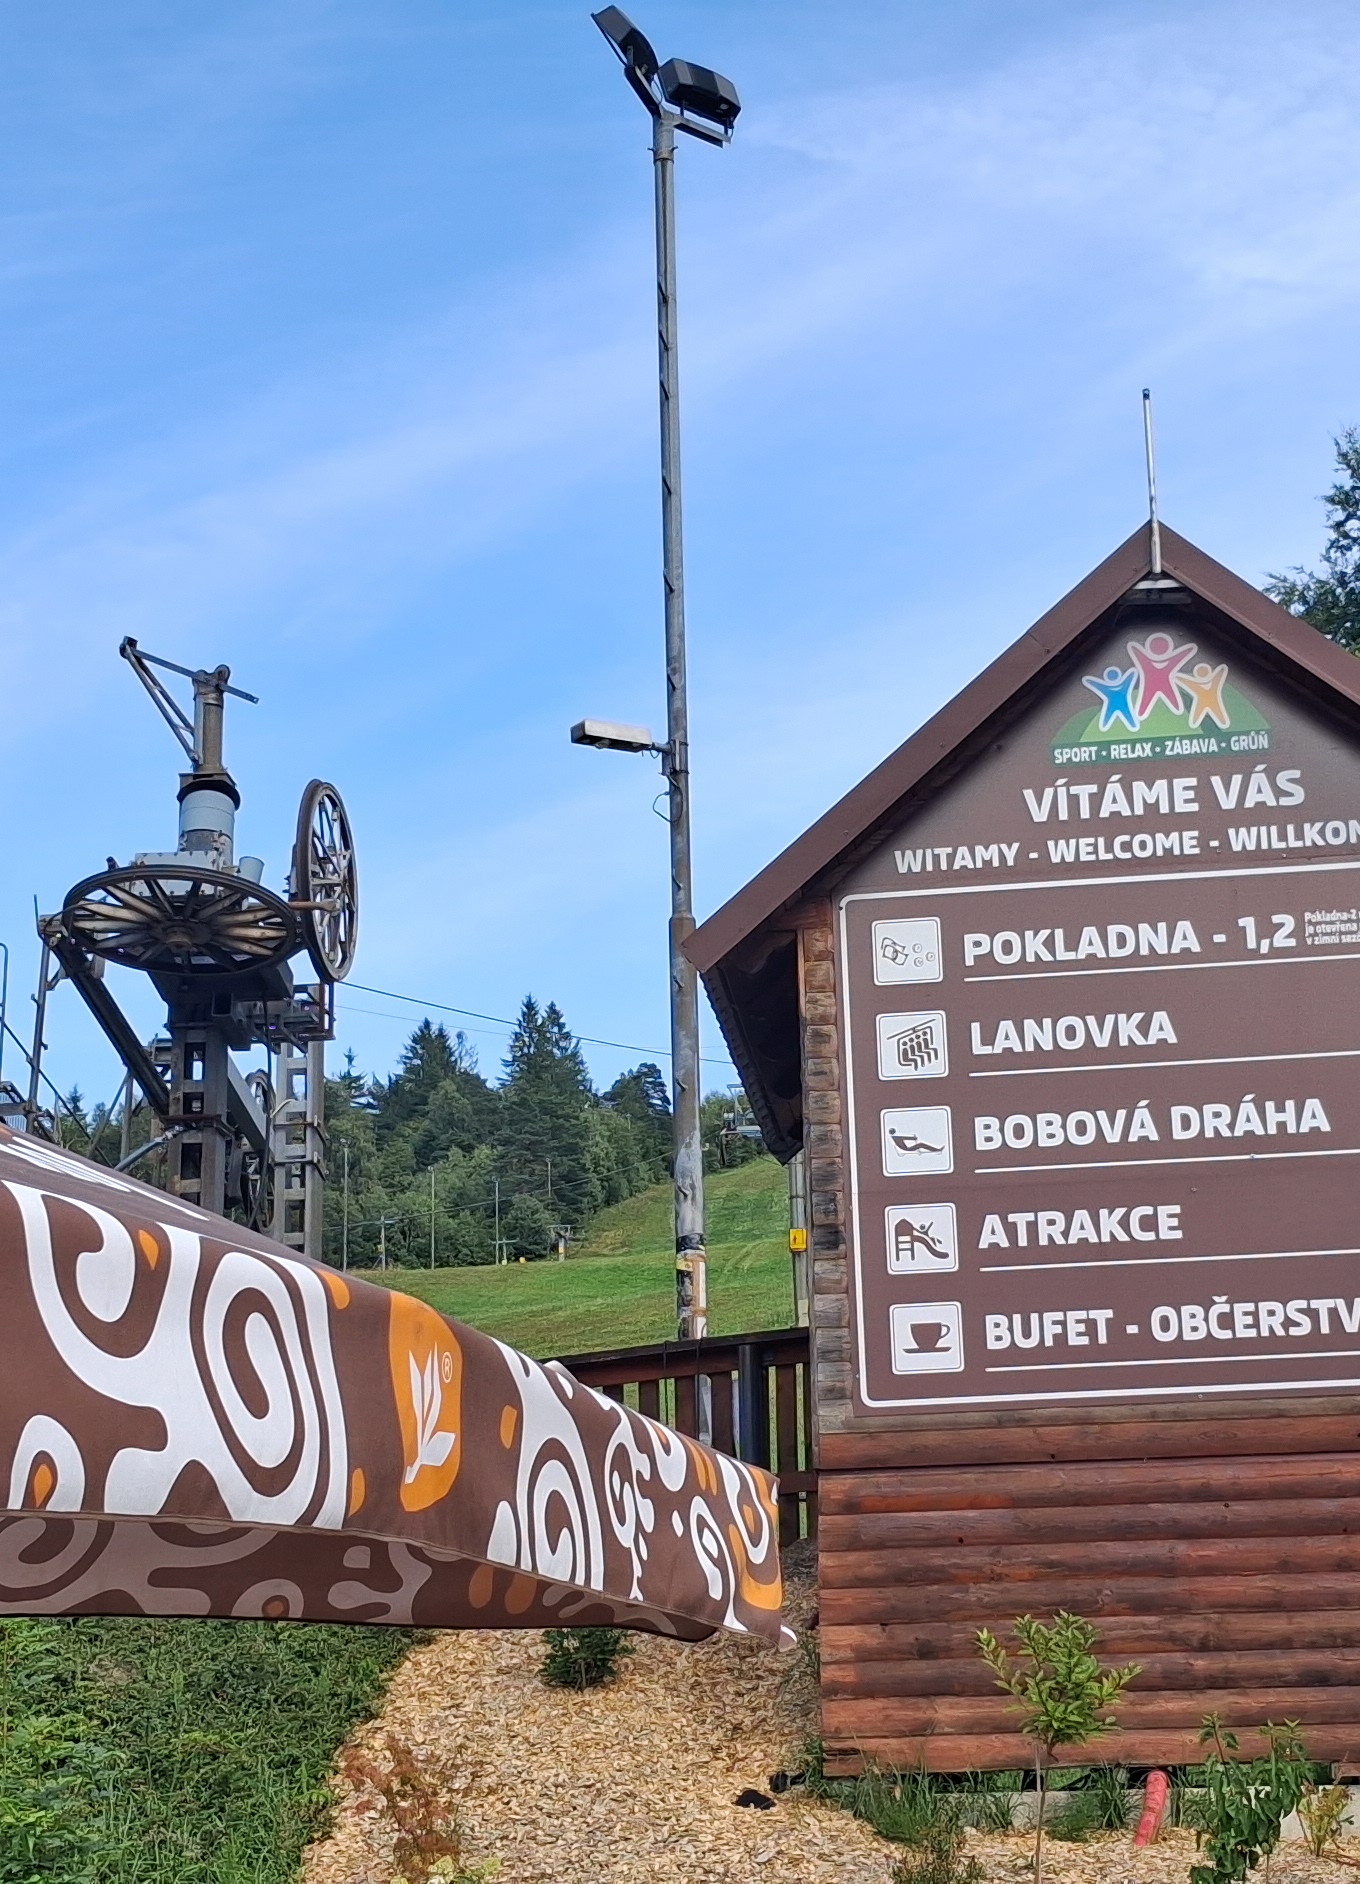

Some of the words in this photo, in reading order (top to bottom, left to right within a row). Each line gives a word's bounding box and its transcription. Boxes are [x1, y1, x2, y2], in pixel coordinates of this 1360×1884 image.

[1053, 746, 1098, 764] SPORT
[1110, 741, 1153, 760] RELAX
[1164, 736, 1219, 756] ZÁBAVA
[1022, 774, 1200, 823] VÍTÁME
[1209, 765, 1305, 810] VÁS
[894, 842, 1021, 874] WITAMY
[1046, 830, 1201, 864] WELCOME
[963, 920, 1201, 967] POKLADNA
[1237, 913, 1297, 954] 1,2
[1305, 923, 1315, 937] je
[1315, 921, 1358, 934] otevřena
[1313, 934, 1340, 945] zimní
[970, 1010, 1178, 1055] LANOVKA
[974, 1100, 1160, 1151] BOBOVÁ
[1170, 1094, 1332, 1140] DRÁHA
[978, 1204, 1184, 1249] ATRAKCE
[985, 1308, 1114, 1350] BUFET
